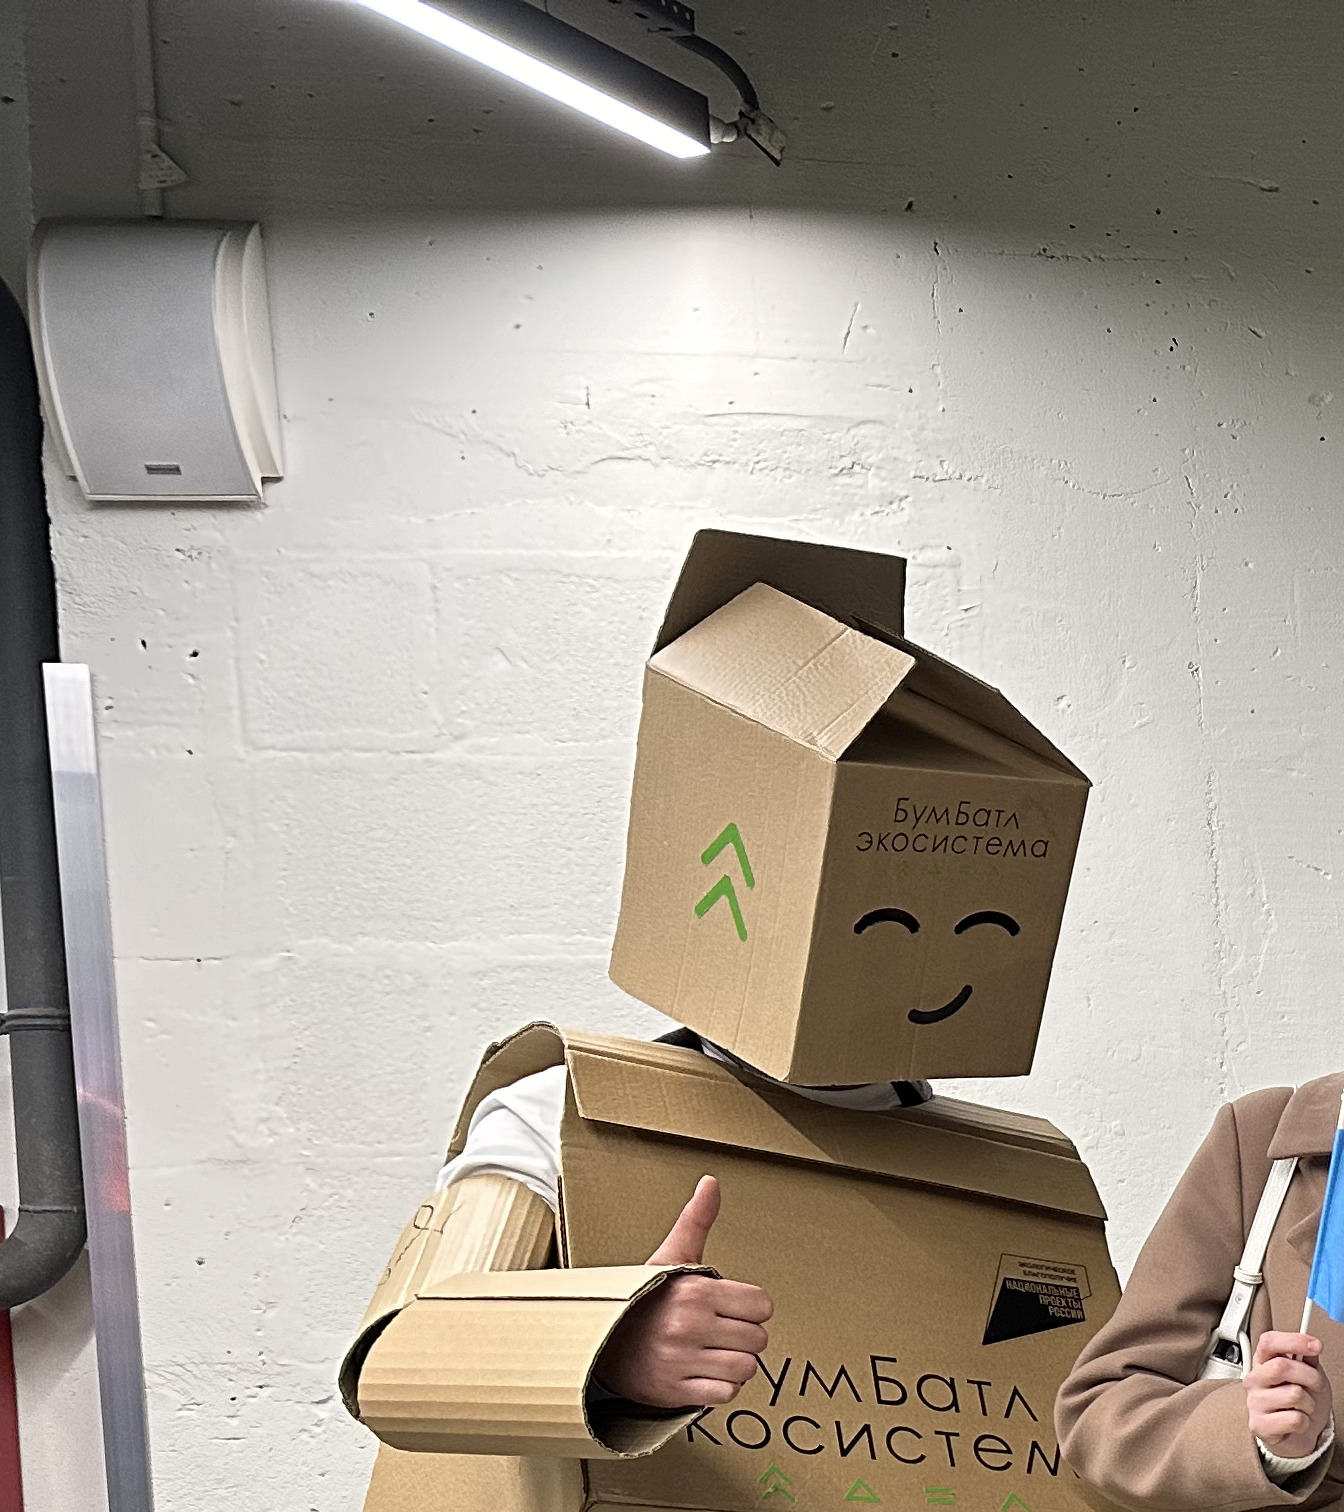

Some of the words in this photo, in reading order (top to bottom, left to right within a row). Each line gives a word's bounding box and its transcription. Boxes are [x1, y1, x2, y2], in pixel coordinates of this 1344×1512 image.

[894, 798, 1019, 830] БумБатл
[856, 831, 1050, 859] экосистема
[1005, 1280, 1079, 1298] НАЦИОНАЛЬНЫЕ
[1039, 1294, 1082, 1309] ПРОЕКТЫ
[1048, 1306, 1084, 1320] РОССИИ
[754, 1354, 1039, 1423] умБатл
[686, 1406, 1080, 1479] косистем
